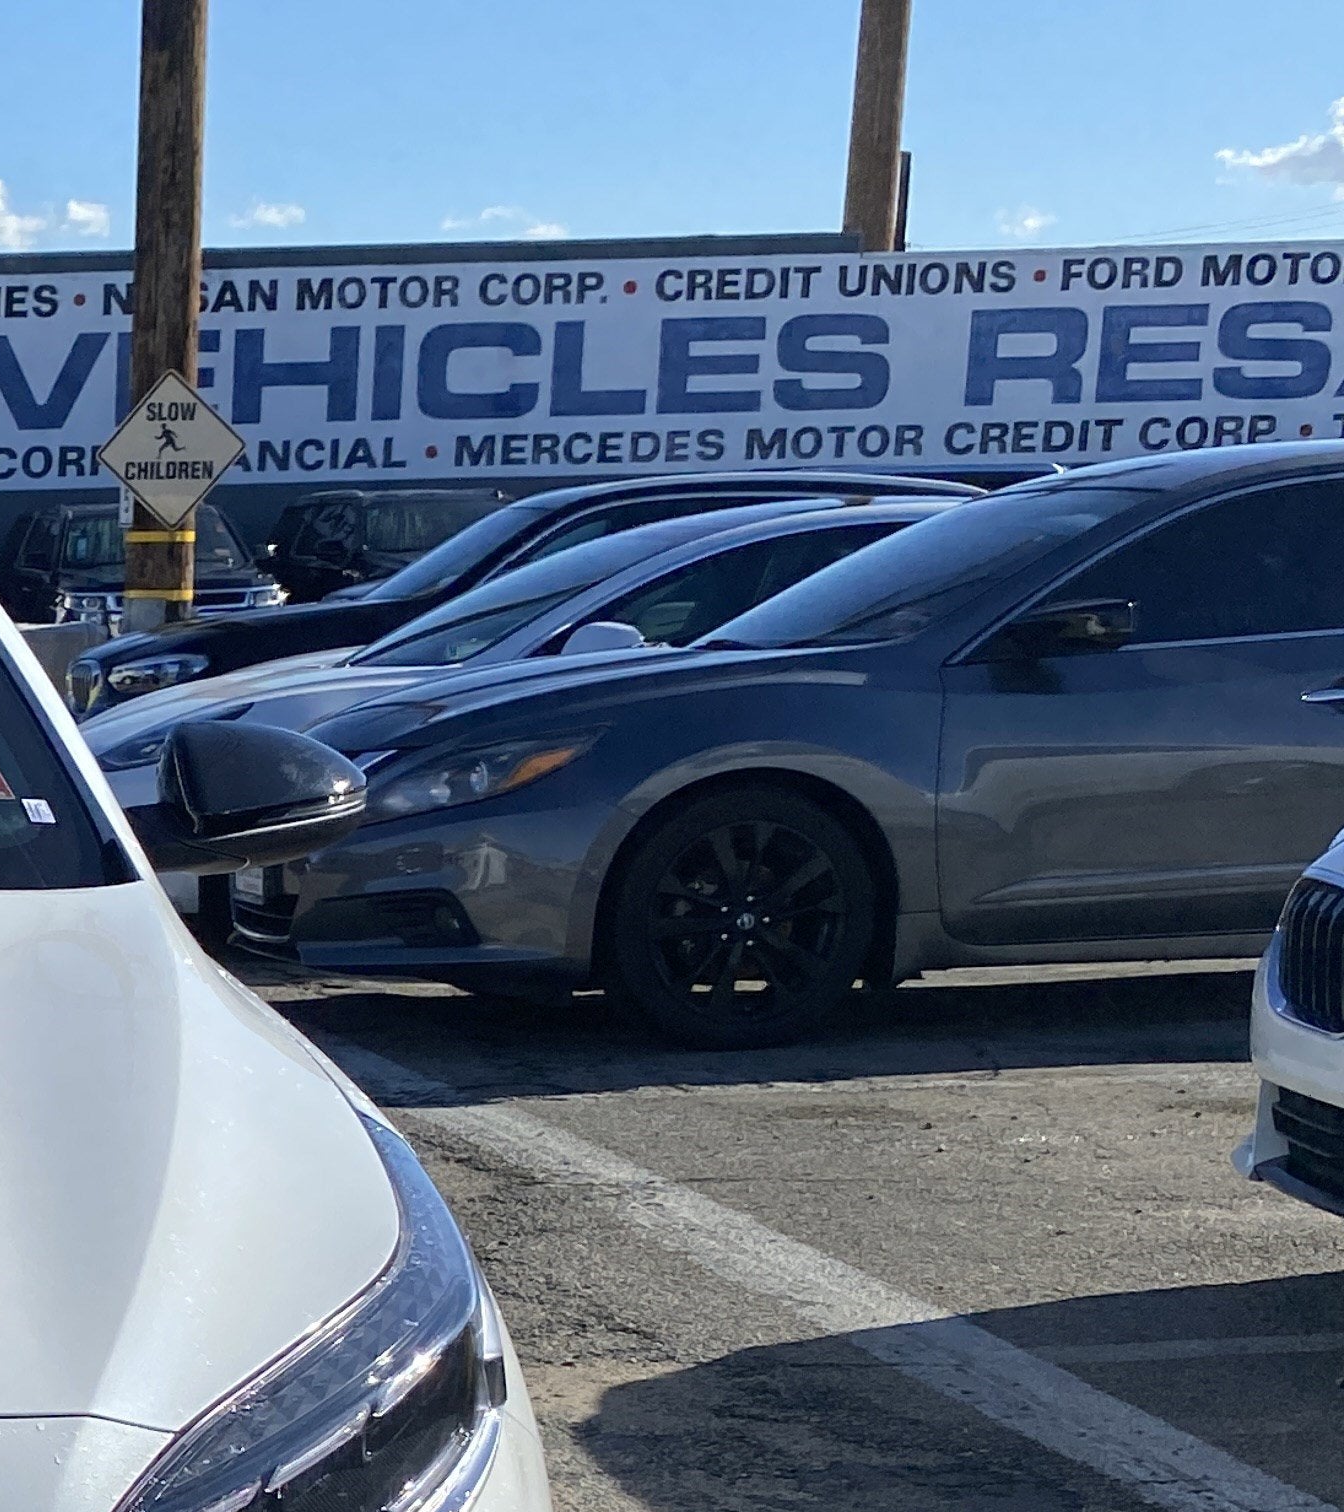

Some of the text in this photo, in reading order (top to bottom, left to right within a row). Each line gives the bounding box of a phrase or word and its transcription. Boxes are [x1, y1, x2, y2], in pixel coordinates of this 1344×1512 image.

[295, 274, 460, 312] MOTOR
[478, 271, 608, 307] CORP.
[655, 266, 822, 303] CREDIT
[838, 260, 1016, 299] UNIONS
[1060, 255, 1184, 293] FORD
[1200, 250, 1344, 288] MOTO
[964, 300, 1344, 407] RES
[145, 402, 198, 421] SLOW
[453, 428, 725, 467] MERCEDES
[744, 424, 924, 462] MOTOR
[943, 418, 1124, 456] CREDIT
[124, 460, 214, 480] CHILDREN
